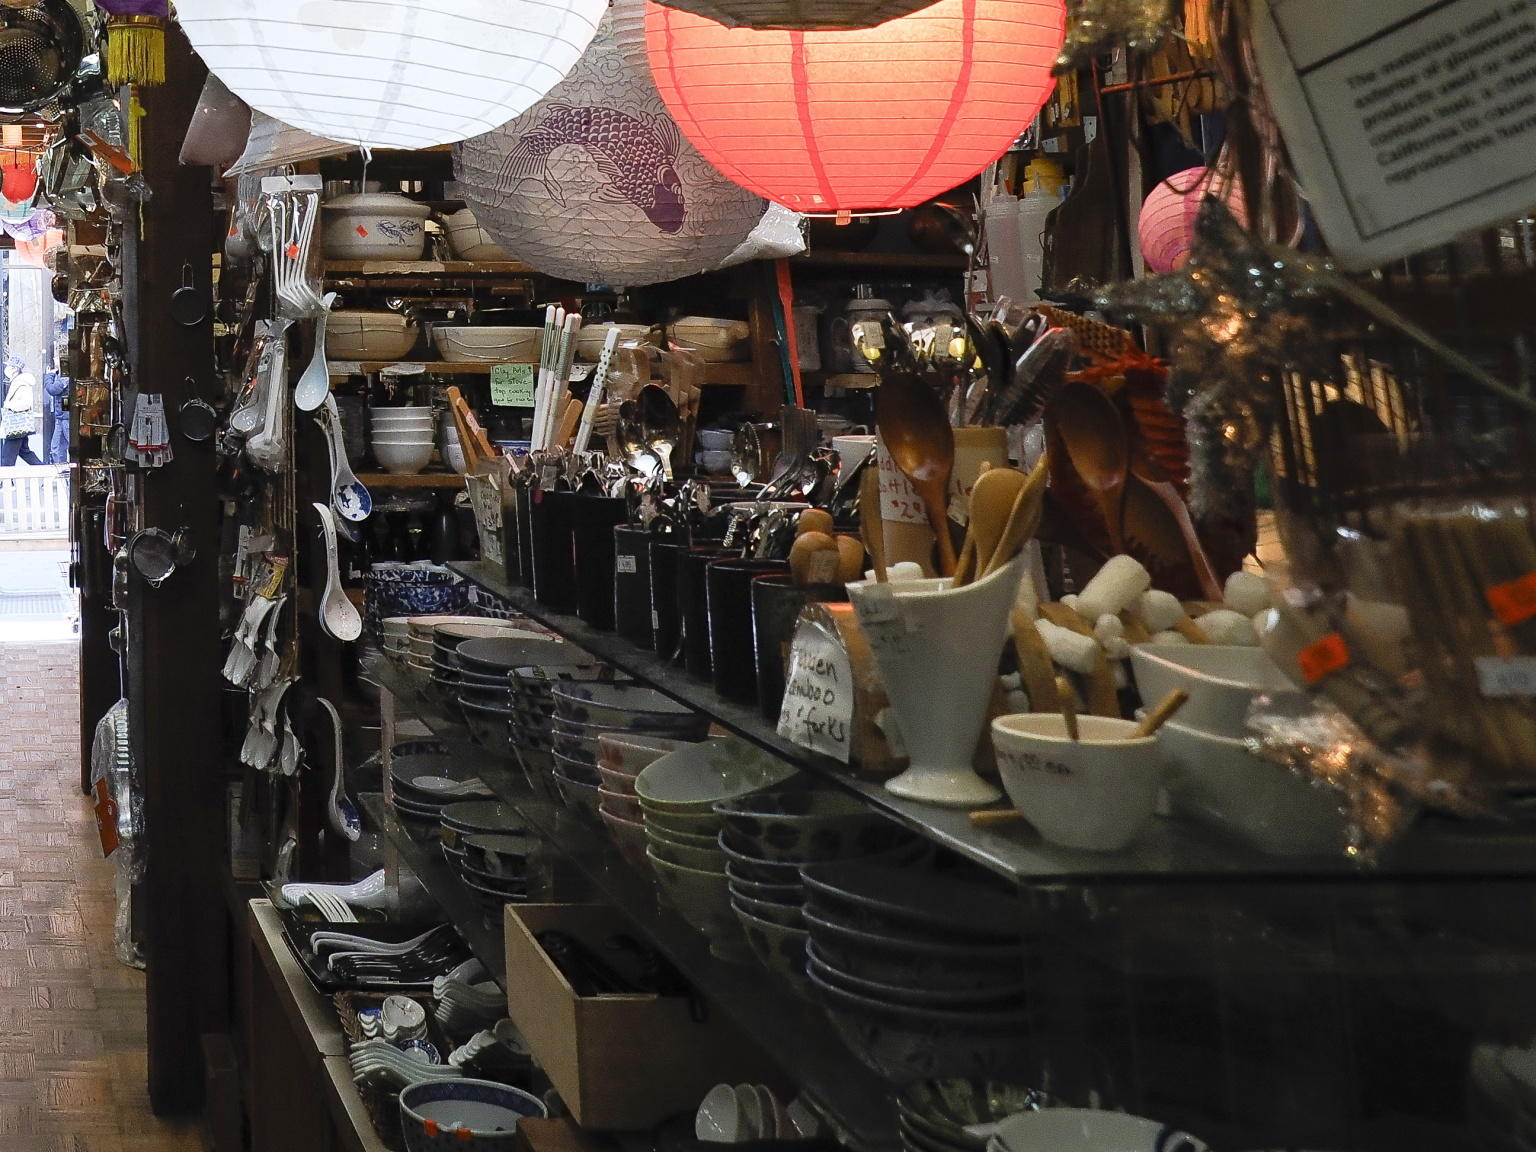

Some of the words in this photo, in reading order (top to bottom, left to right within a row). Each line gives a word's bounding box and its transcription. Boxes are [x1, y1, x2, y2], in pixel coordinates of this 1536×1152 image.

[1346, 71, 1377, 89] The
[1380, 32, 1458, 74] materials
[1354, 74, 1418, 109] exterior
[1362, 89, 1435, 131] products
[1370, 114, 1432, 148] contain
[1376, 126, 1459, 166] California
[1384, 135, 1495, 186] reproductive
[803, 706, 844, 745] forks
